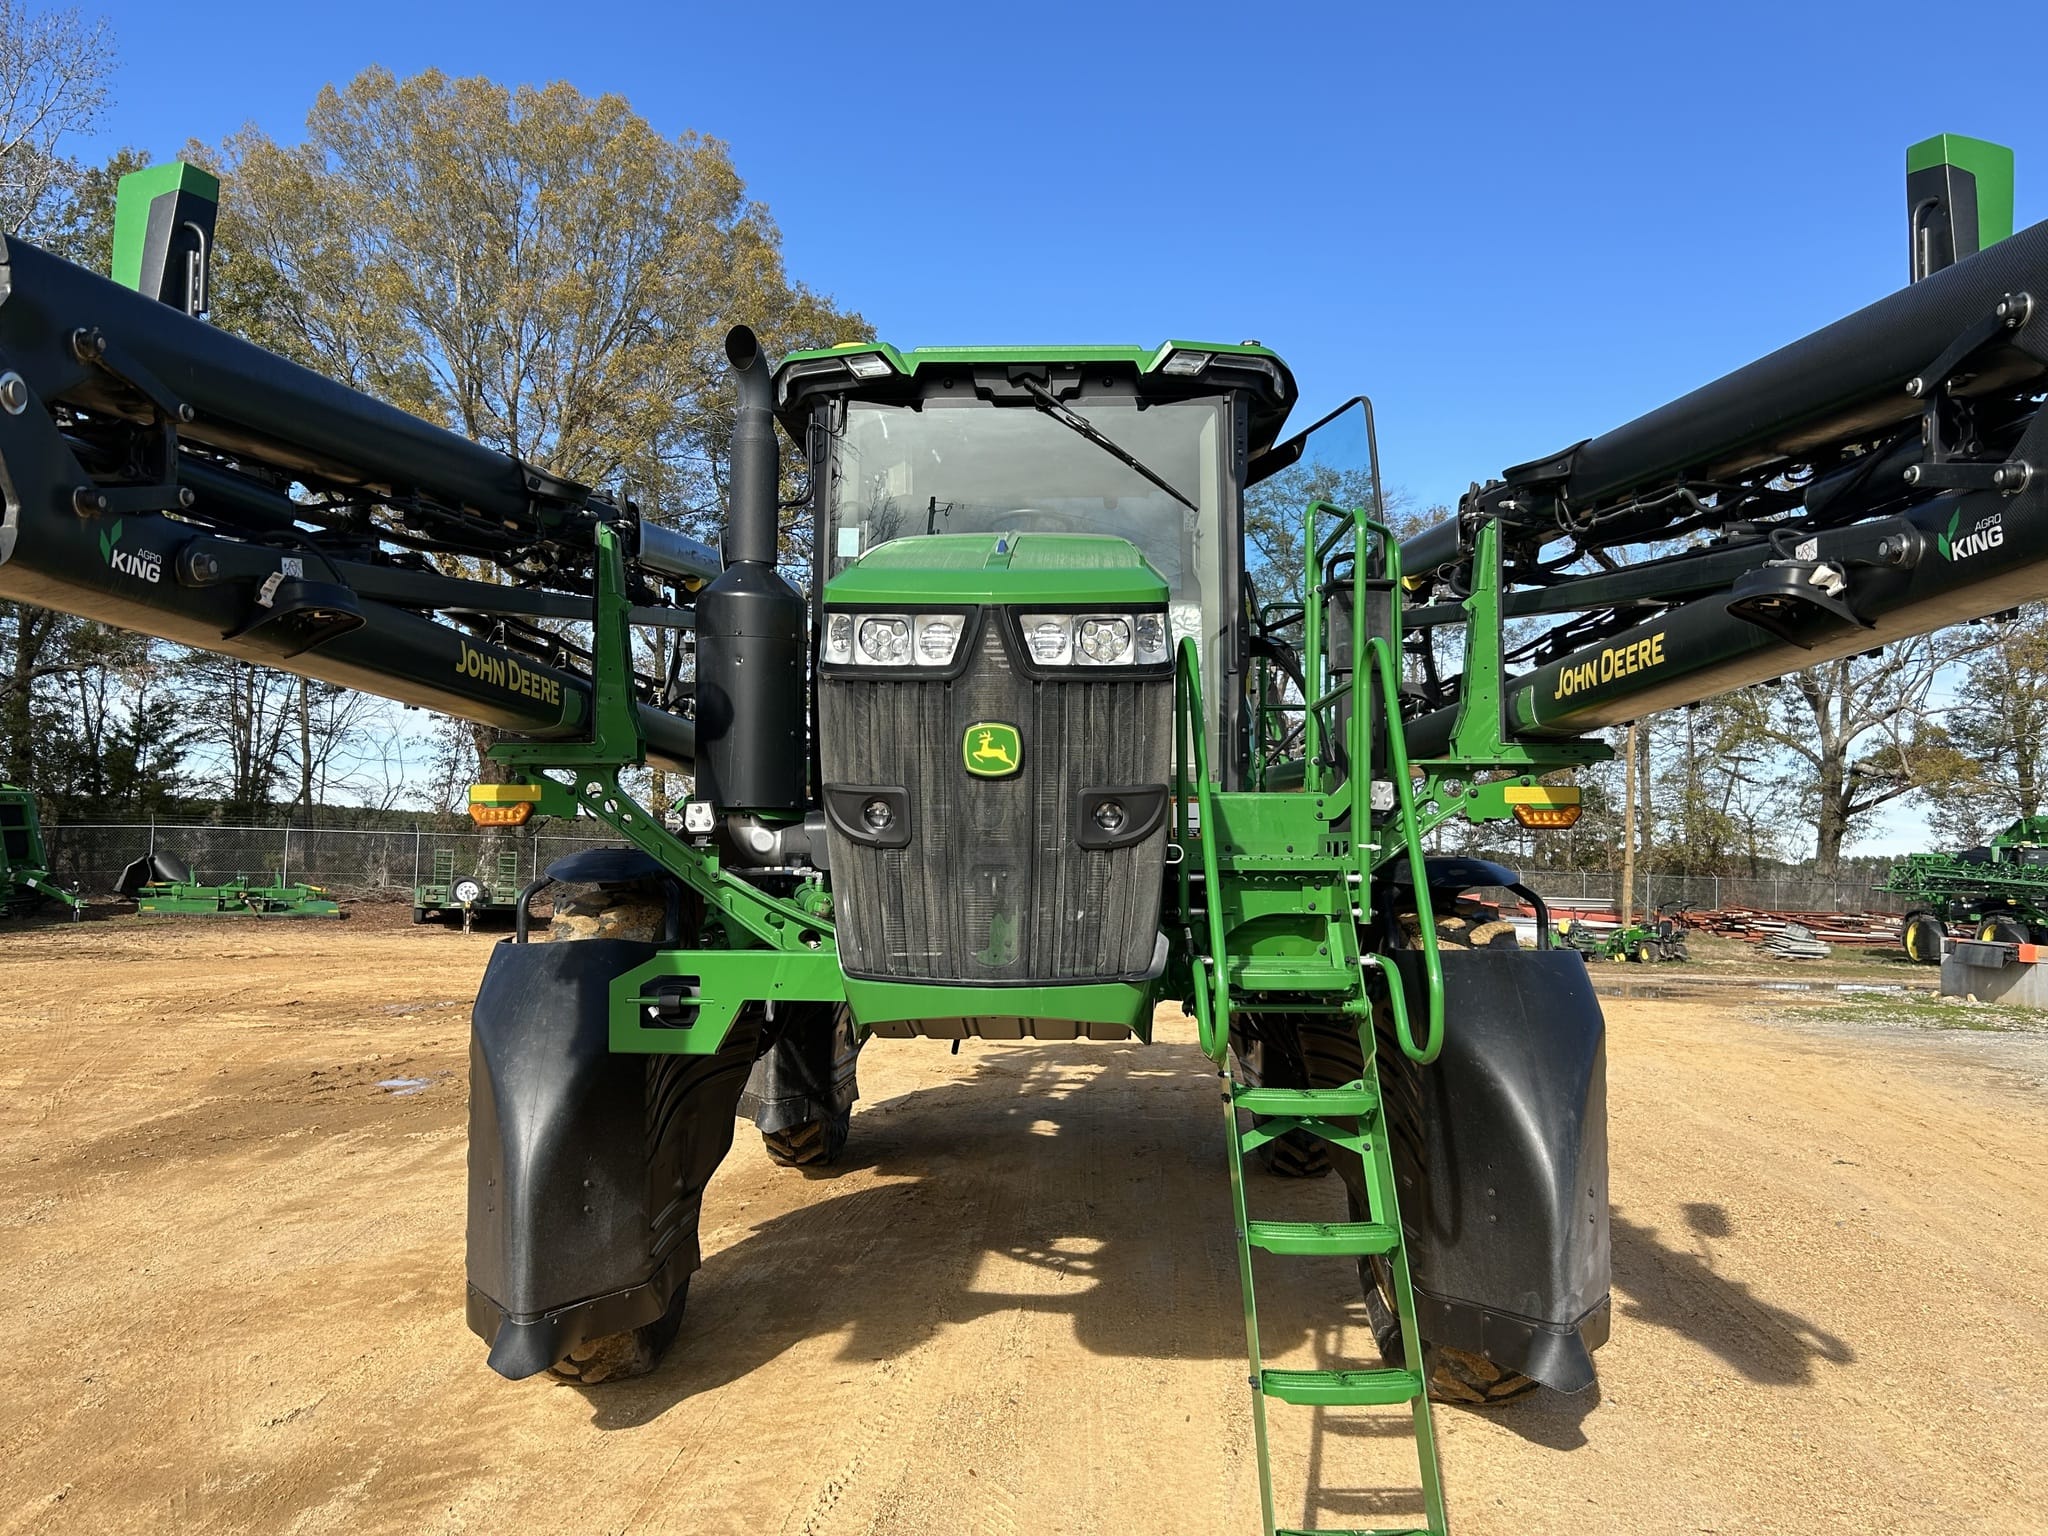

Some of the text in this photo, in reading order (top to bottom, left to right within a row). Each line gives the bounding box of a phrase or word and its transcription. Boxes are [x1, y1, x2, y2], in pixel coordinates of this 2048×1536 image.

[1974, 513, 2002, 532] AGRO
[137, 548, 162, 565] AGRO
[1951, 525, 2004, 561] KING
[111, 549, 161, 584] KING
[455, 640, 560, 706] JOHN DEERE
[1554, 632, 1665, 700] JOHN DEERE
